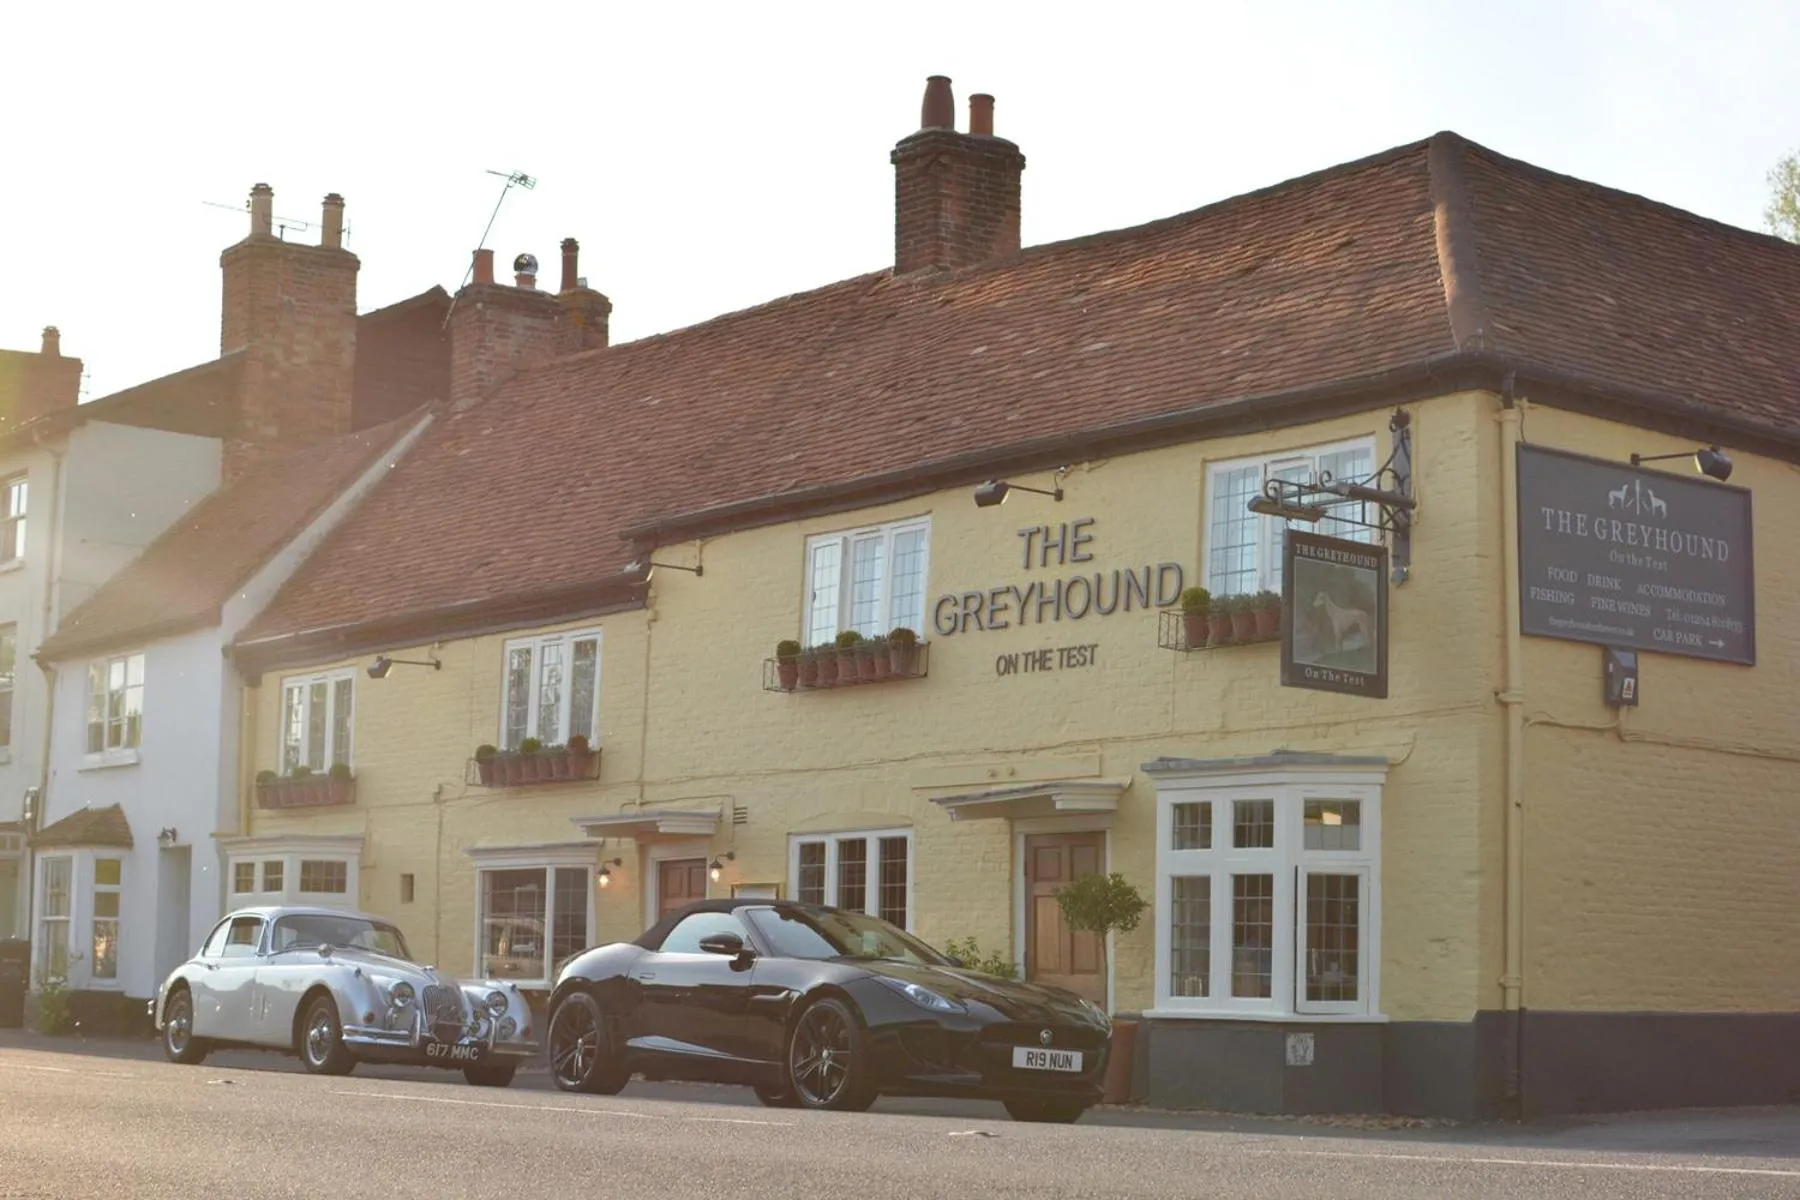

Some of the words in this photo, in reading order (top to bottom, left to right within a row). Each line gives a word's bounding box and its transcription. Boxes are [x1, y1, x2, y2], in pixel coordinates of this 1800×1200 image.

[1017, 517, 1096, 570] THE
[1541, 507, 1588, 538] THE
[1594, 517, 1729, 562] GREYHOUND
[1296, 543, 1316, 557] THE
[1316, 547, 1378, 569] GREYHOUND
[1609, 550, 1625, 564] On
[1626, 553, 1644, 567] the
[1645, 556, 1668, 571] Test
[1547, 567, 1578, 583] FOOD
[1587, 573, 1622, 590] DRINK
[933, 562, 1184, 637] GREYHOUND
[1529, 586, 1575, 605] FISHING
[1590, 596, 1616, 612] FINE
[1617, 600, 1652, 618] WINES
[1652, 627, 1674, 643] CAR
[1676, 631, 1704, 648] PARK
[996, 653, 1018, 677] ON
[1022, 647, 1053, 674] THE
[1056, 643, 1099, 670] TEST
[1305, 667, 1319, 679] On
[426, 1043, 449, 1057] 617
[450, 1045, 480, 1060] MMC
[1026, 1051, 1047, 1068] R19
[1049, 1052, 1074, 1069] NUN
